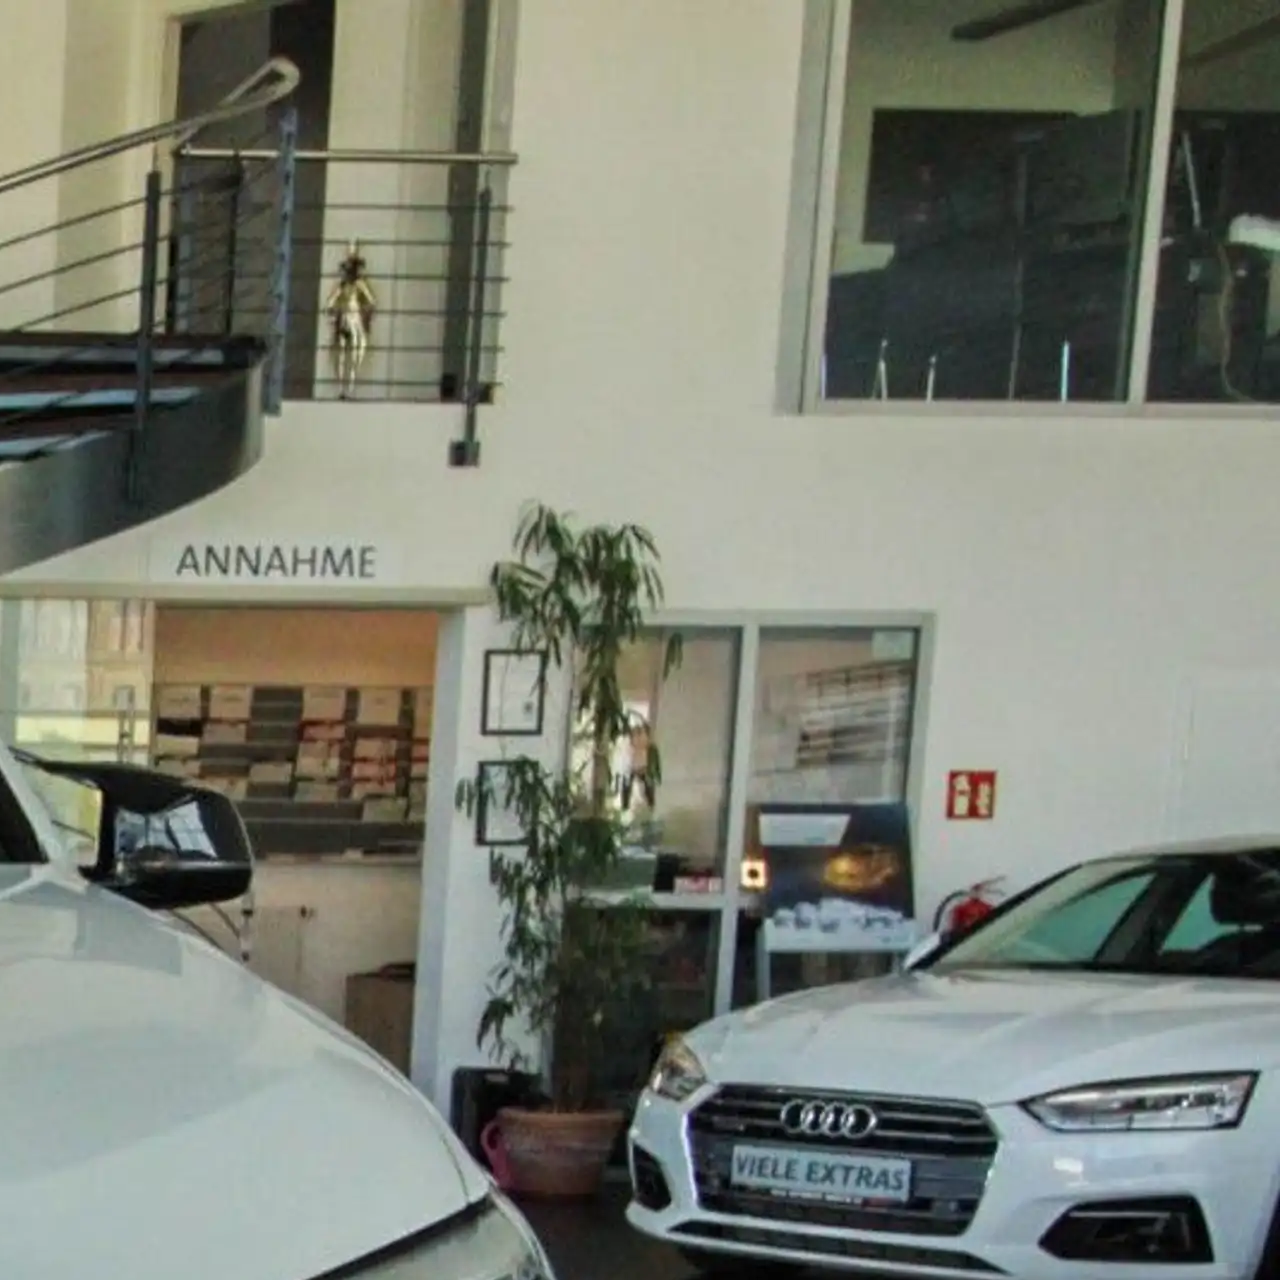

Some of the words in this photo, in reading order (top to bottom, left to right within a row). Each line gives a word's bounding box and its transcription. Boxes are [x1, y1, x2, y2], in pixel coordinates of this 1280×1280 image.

[176, 544, 376, 578] ANNAHME
[737, 1152, 800, 1181] VIELE
[806, 1160, 905, 1191] EXTRAS
